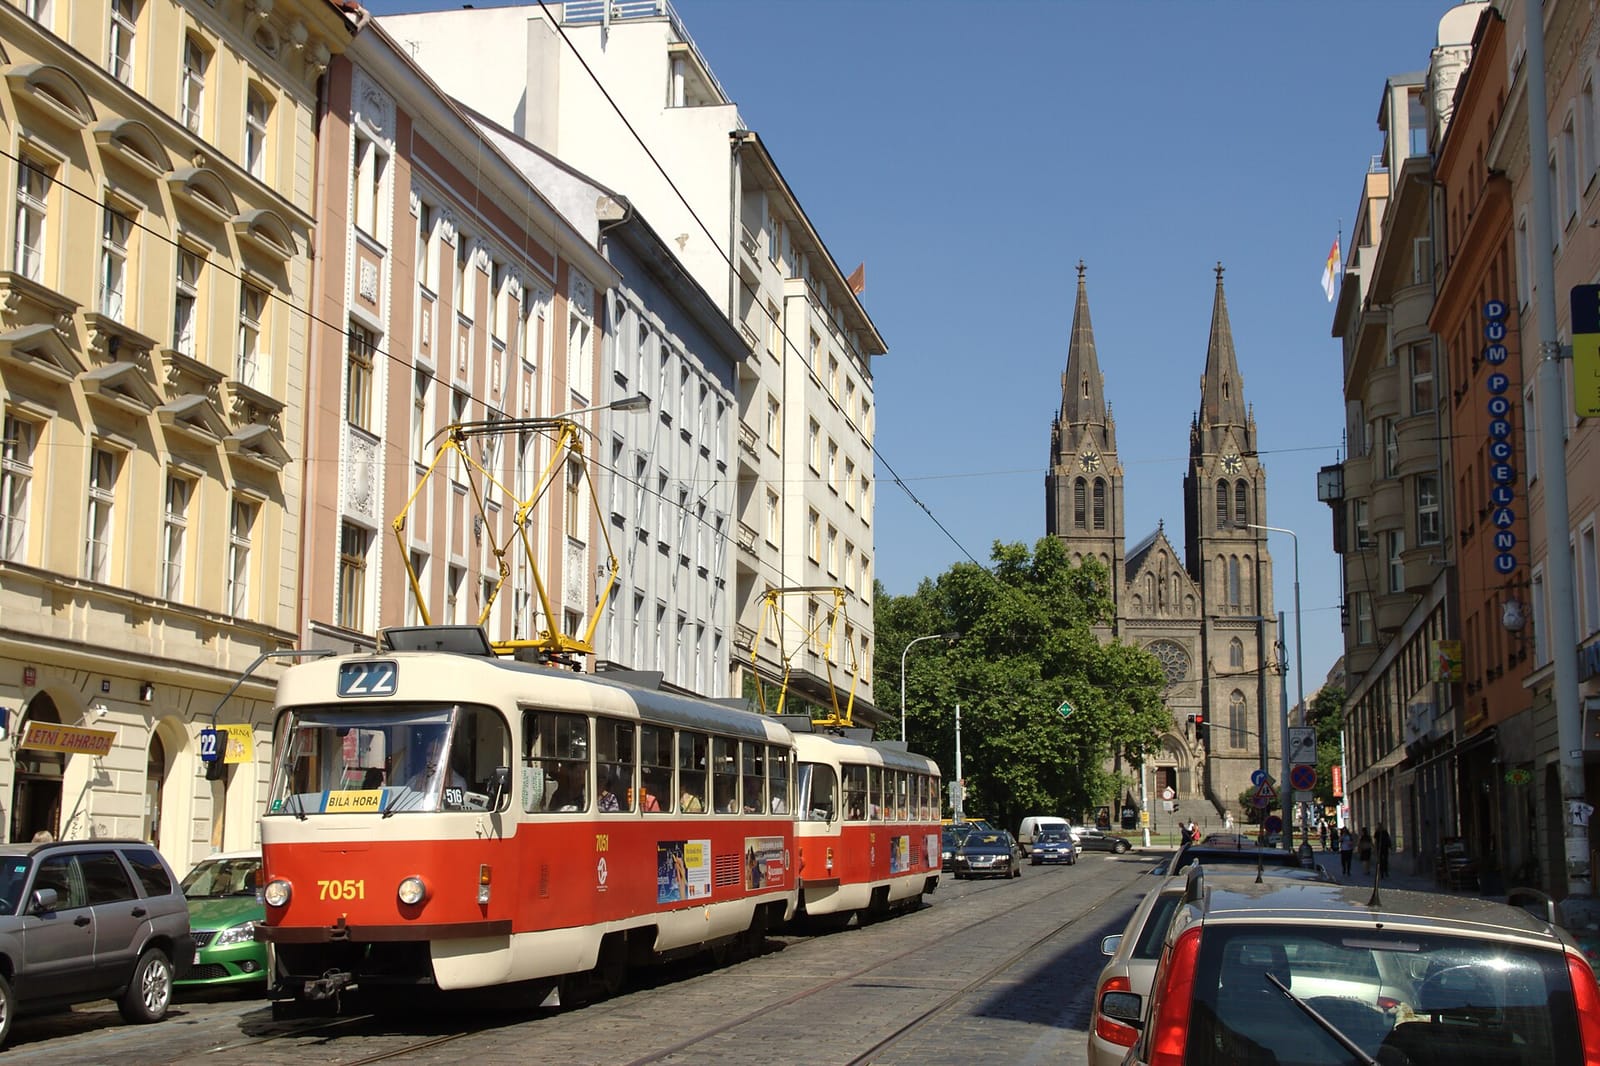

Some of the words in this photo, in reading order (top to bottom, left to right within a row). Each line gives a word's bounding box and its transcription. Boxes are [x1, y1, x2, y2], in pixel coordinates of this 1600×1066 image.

[346, 663, 394, 694] 22
[60, 732, 112, 750] ZAHRADA
[201, 734, 217, 756] 22
[352, 796, 378, 806] HORA
[445, 788, 463, 803] 516
[317, 879, 365, 900] 7051
